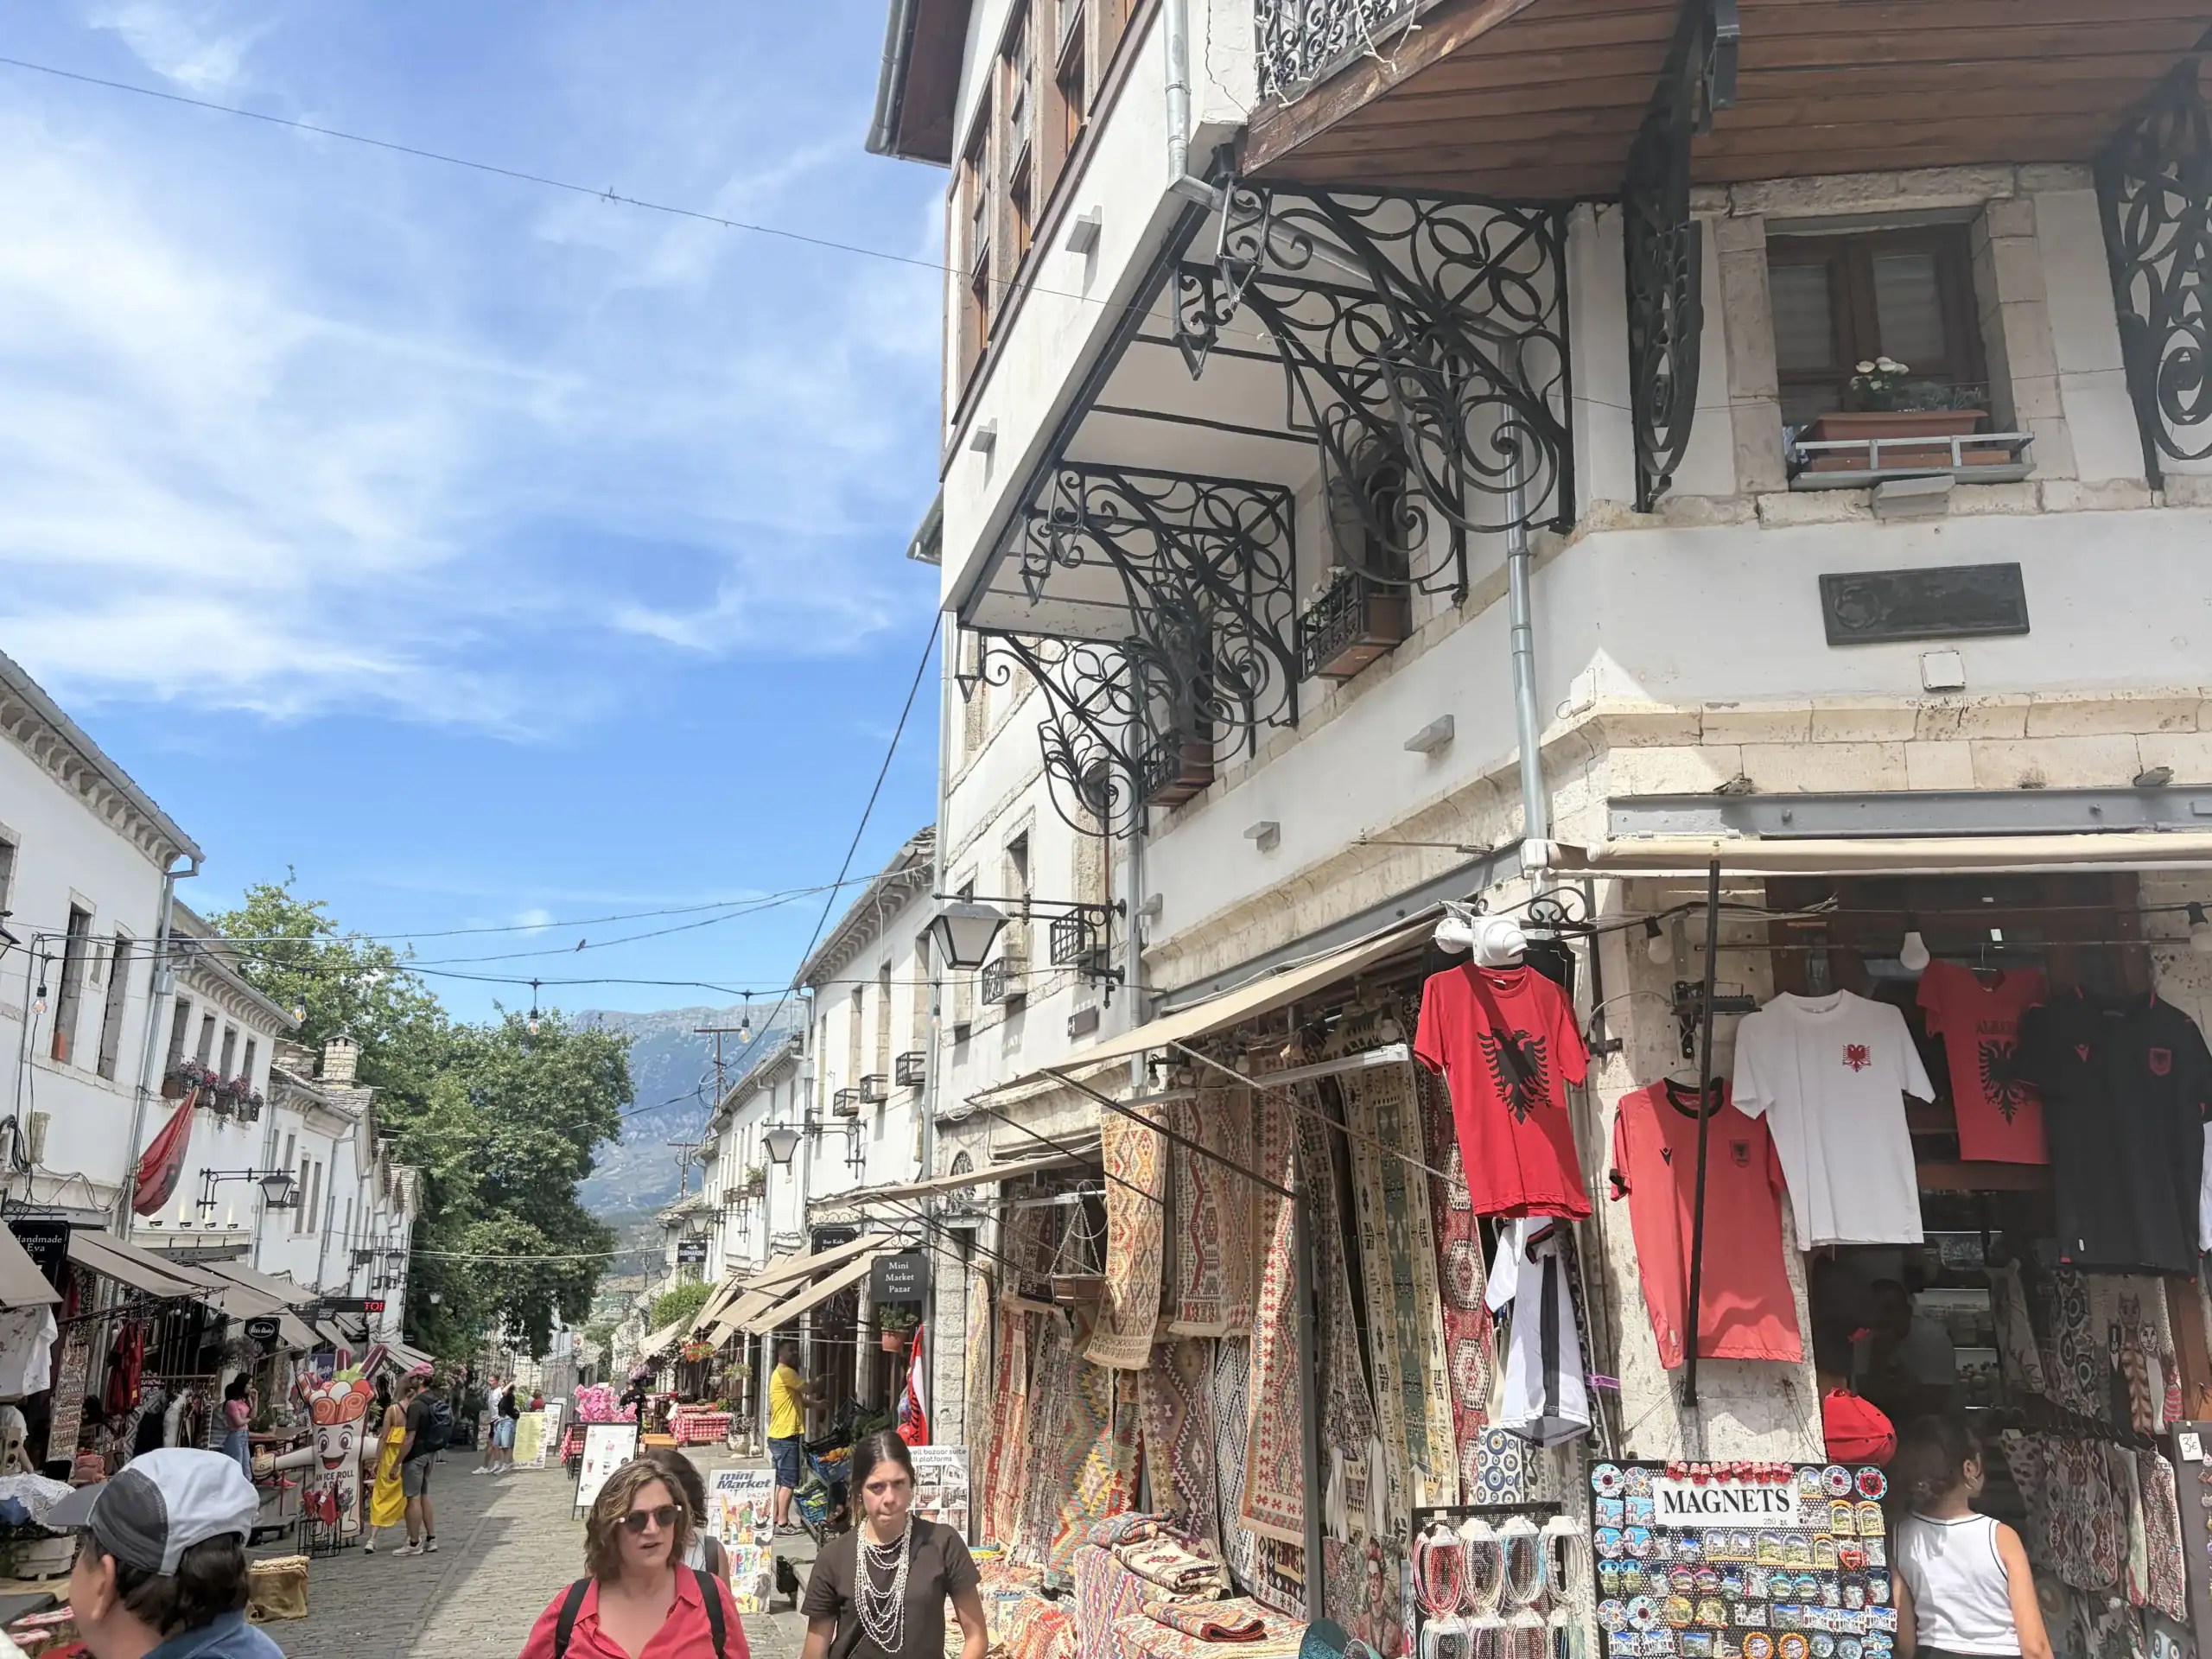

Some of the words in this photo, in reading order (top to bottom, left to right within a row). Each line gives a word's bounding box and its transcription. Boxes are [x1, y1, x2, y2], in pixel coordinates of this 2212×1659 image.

[27, 1243, 46, 1252] Eva
[888, 1262, 909, 1270] Mini
[885, 1273, 915, 1281] Market
[888, 1285, 912, 1294] Pazar
[323, 1471, 335, 1480] ICE
[337, 1470, 354, 1478] ROLL
[720, 1471, 756, 1480] mini
[329, 1479, 344, 1489] DY
[715, 1478, 772, 1490] Market
[1662, 1489, 1790, 1513] MAGNETS
